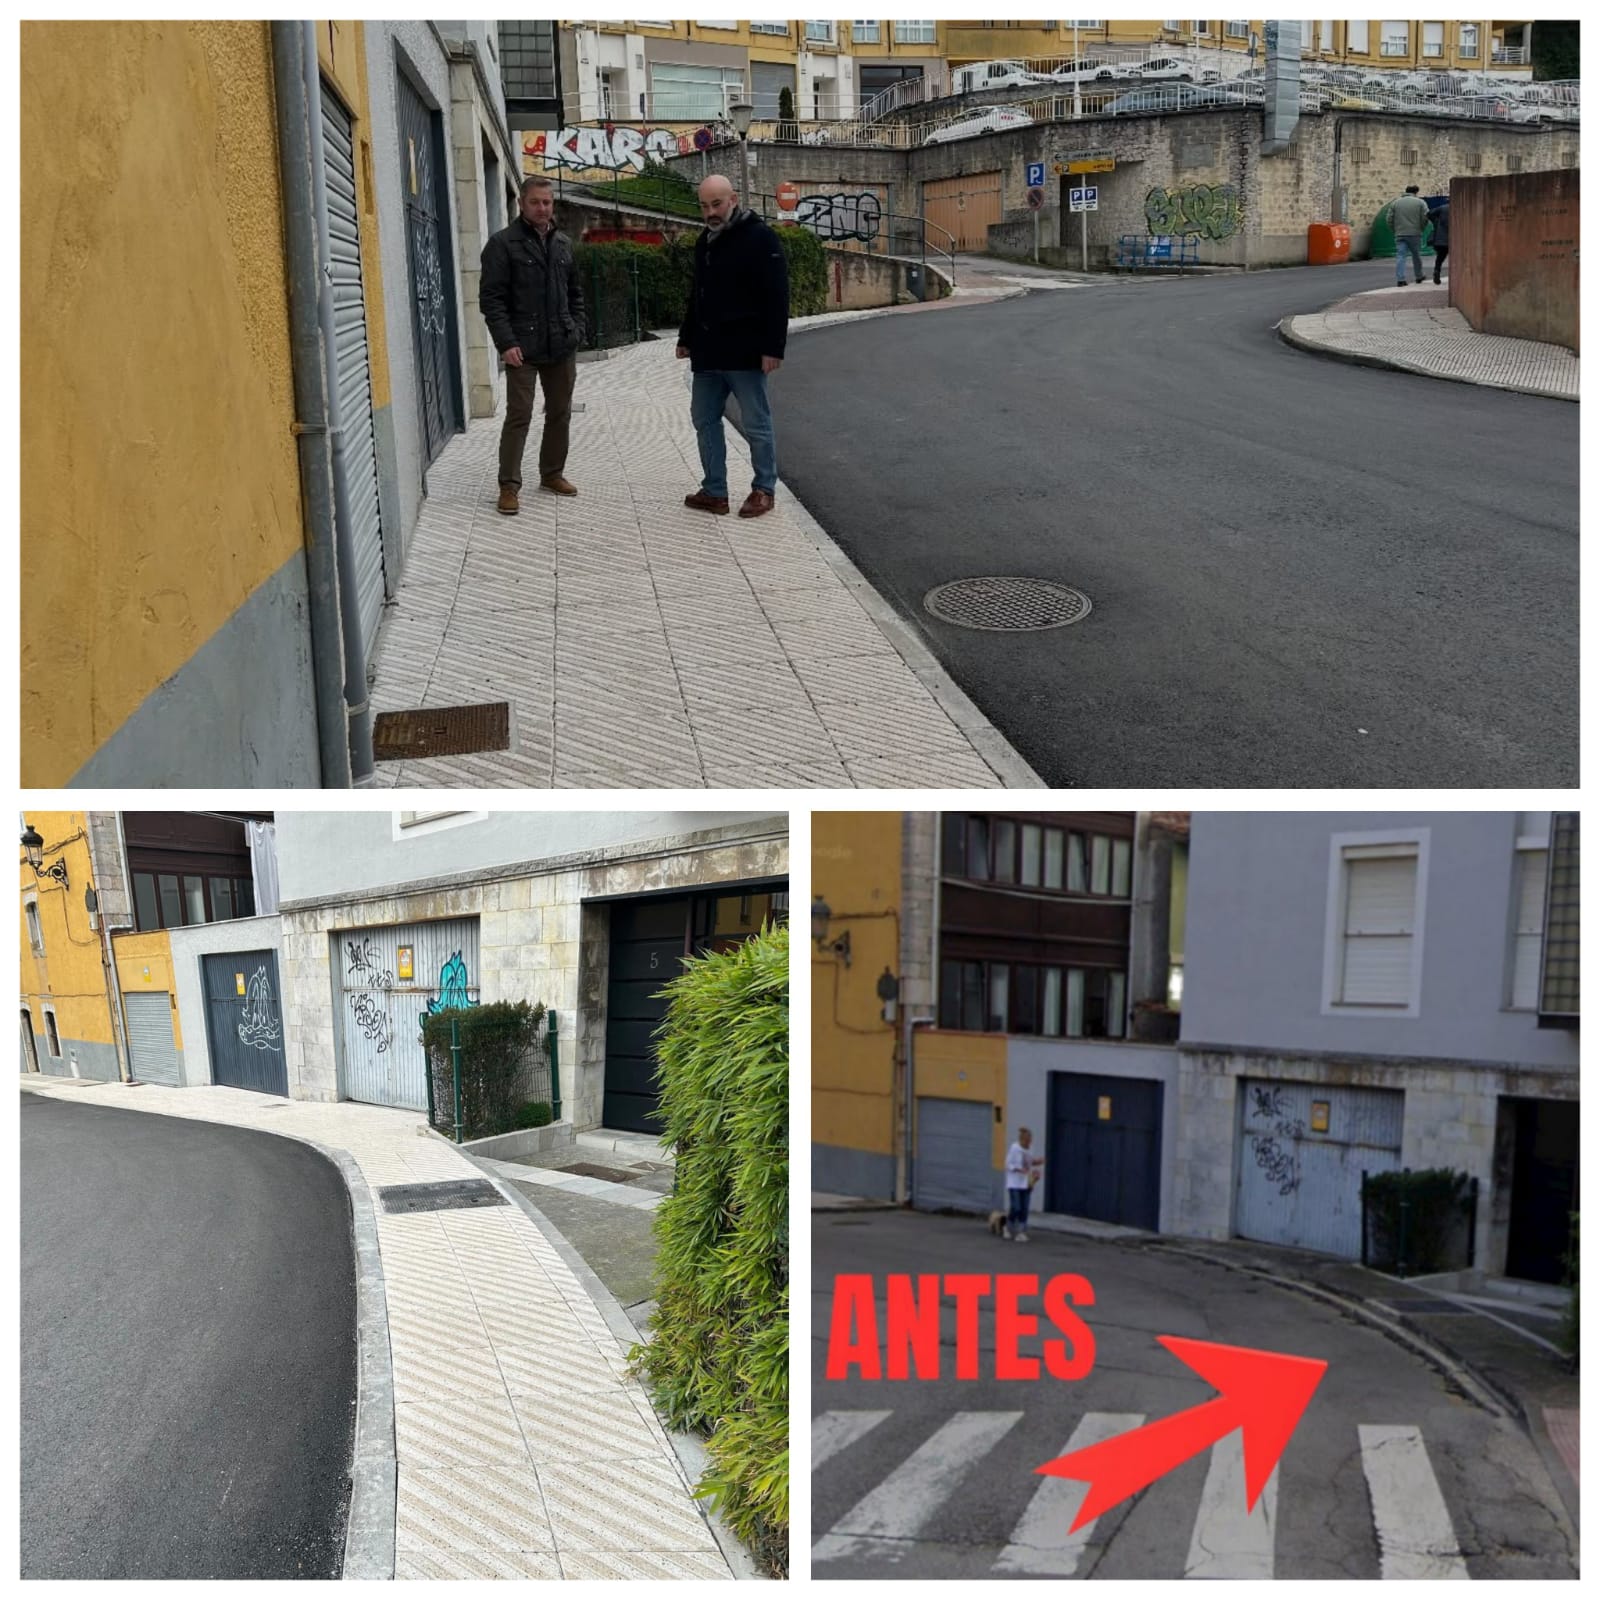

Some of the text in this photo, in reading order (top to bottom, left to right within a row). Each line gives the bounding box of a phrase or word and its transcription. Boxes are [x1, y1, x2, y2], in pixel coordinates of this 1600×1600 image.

[1030, 166, 1041, 184] P
[1073, 190, 1094, 201] P P
[650, 952, 658, 969] 5
